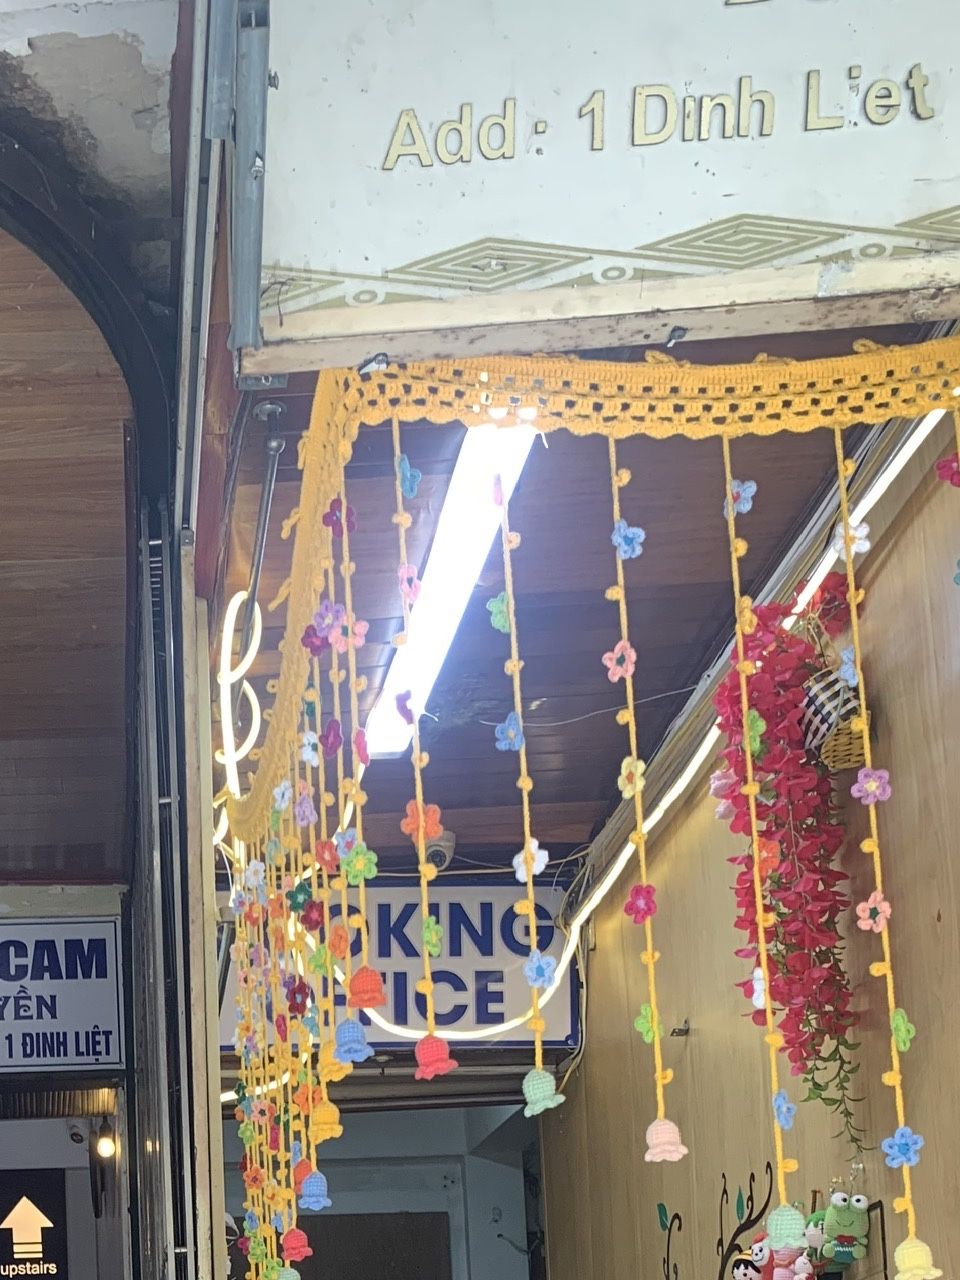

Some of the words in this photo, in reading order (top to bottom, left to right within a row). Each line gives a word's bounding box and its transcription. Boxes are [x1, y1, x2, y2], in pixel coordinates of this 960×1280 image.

[577, 89, 606, 152] 1
[631, 75, 775, 147] Dinh
[4, 1033, 14, 1060] 1
[21, 1030, 69, 1059] ĐINH
[74, 1024, 114, 1063] LIỆT
[0, 1259, 58, 1278] upstairs
